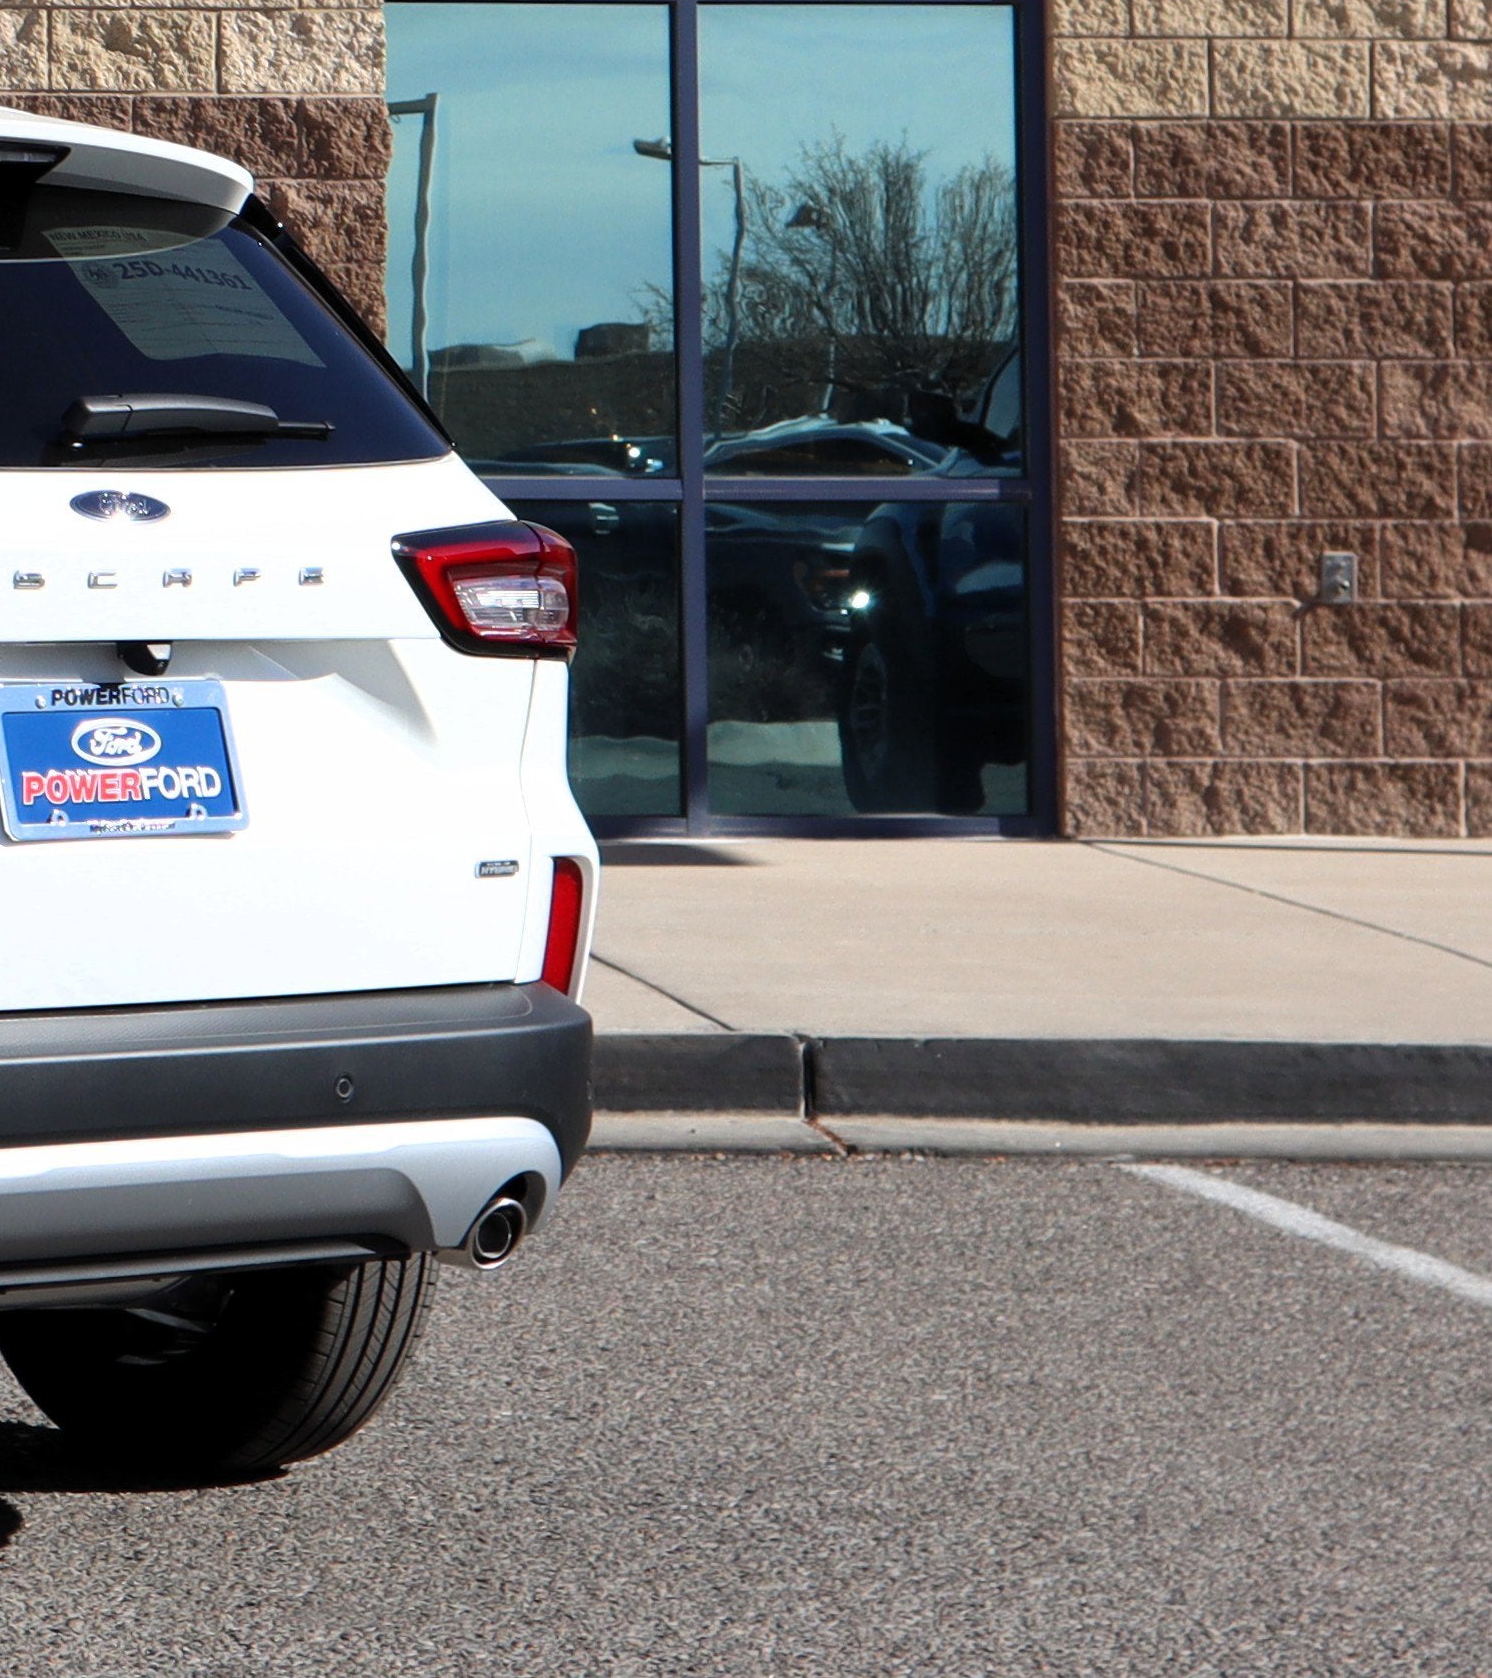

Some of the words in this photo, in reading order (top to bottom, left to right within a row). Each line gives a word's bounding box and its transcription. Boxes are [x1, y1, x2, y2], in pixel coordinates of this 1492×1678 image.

[114, 261, 252, 290] 25D-441361
[51, 686, 170, 706] POWERFORD
[90, 726, 142, 755] Ford
[22, 765, 222, 805] POWERFORD
